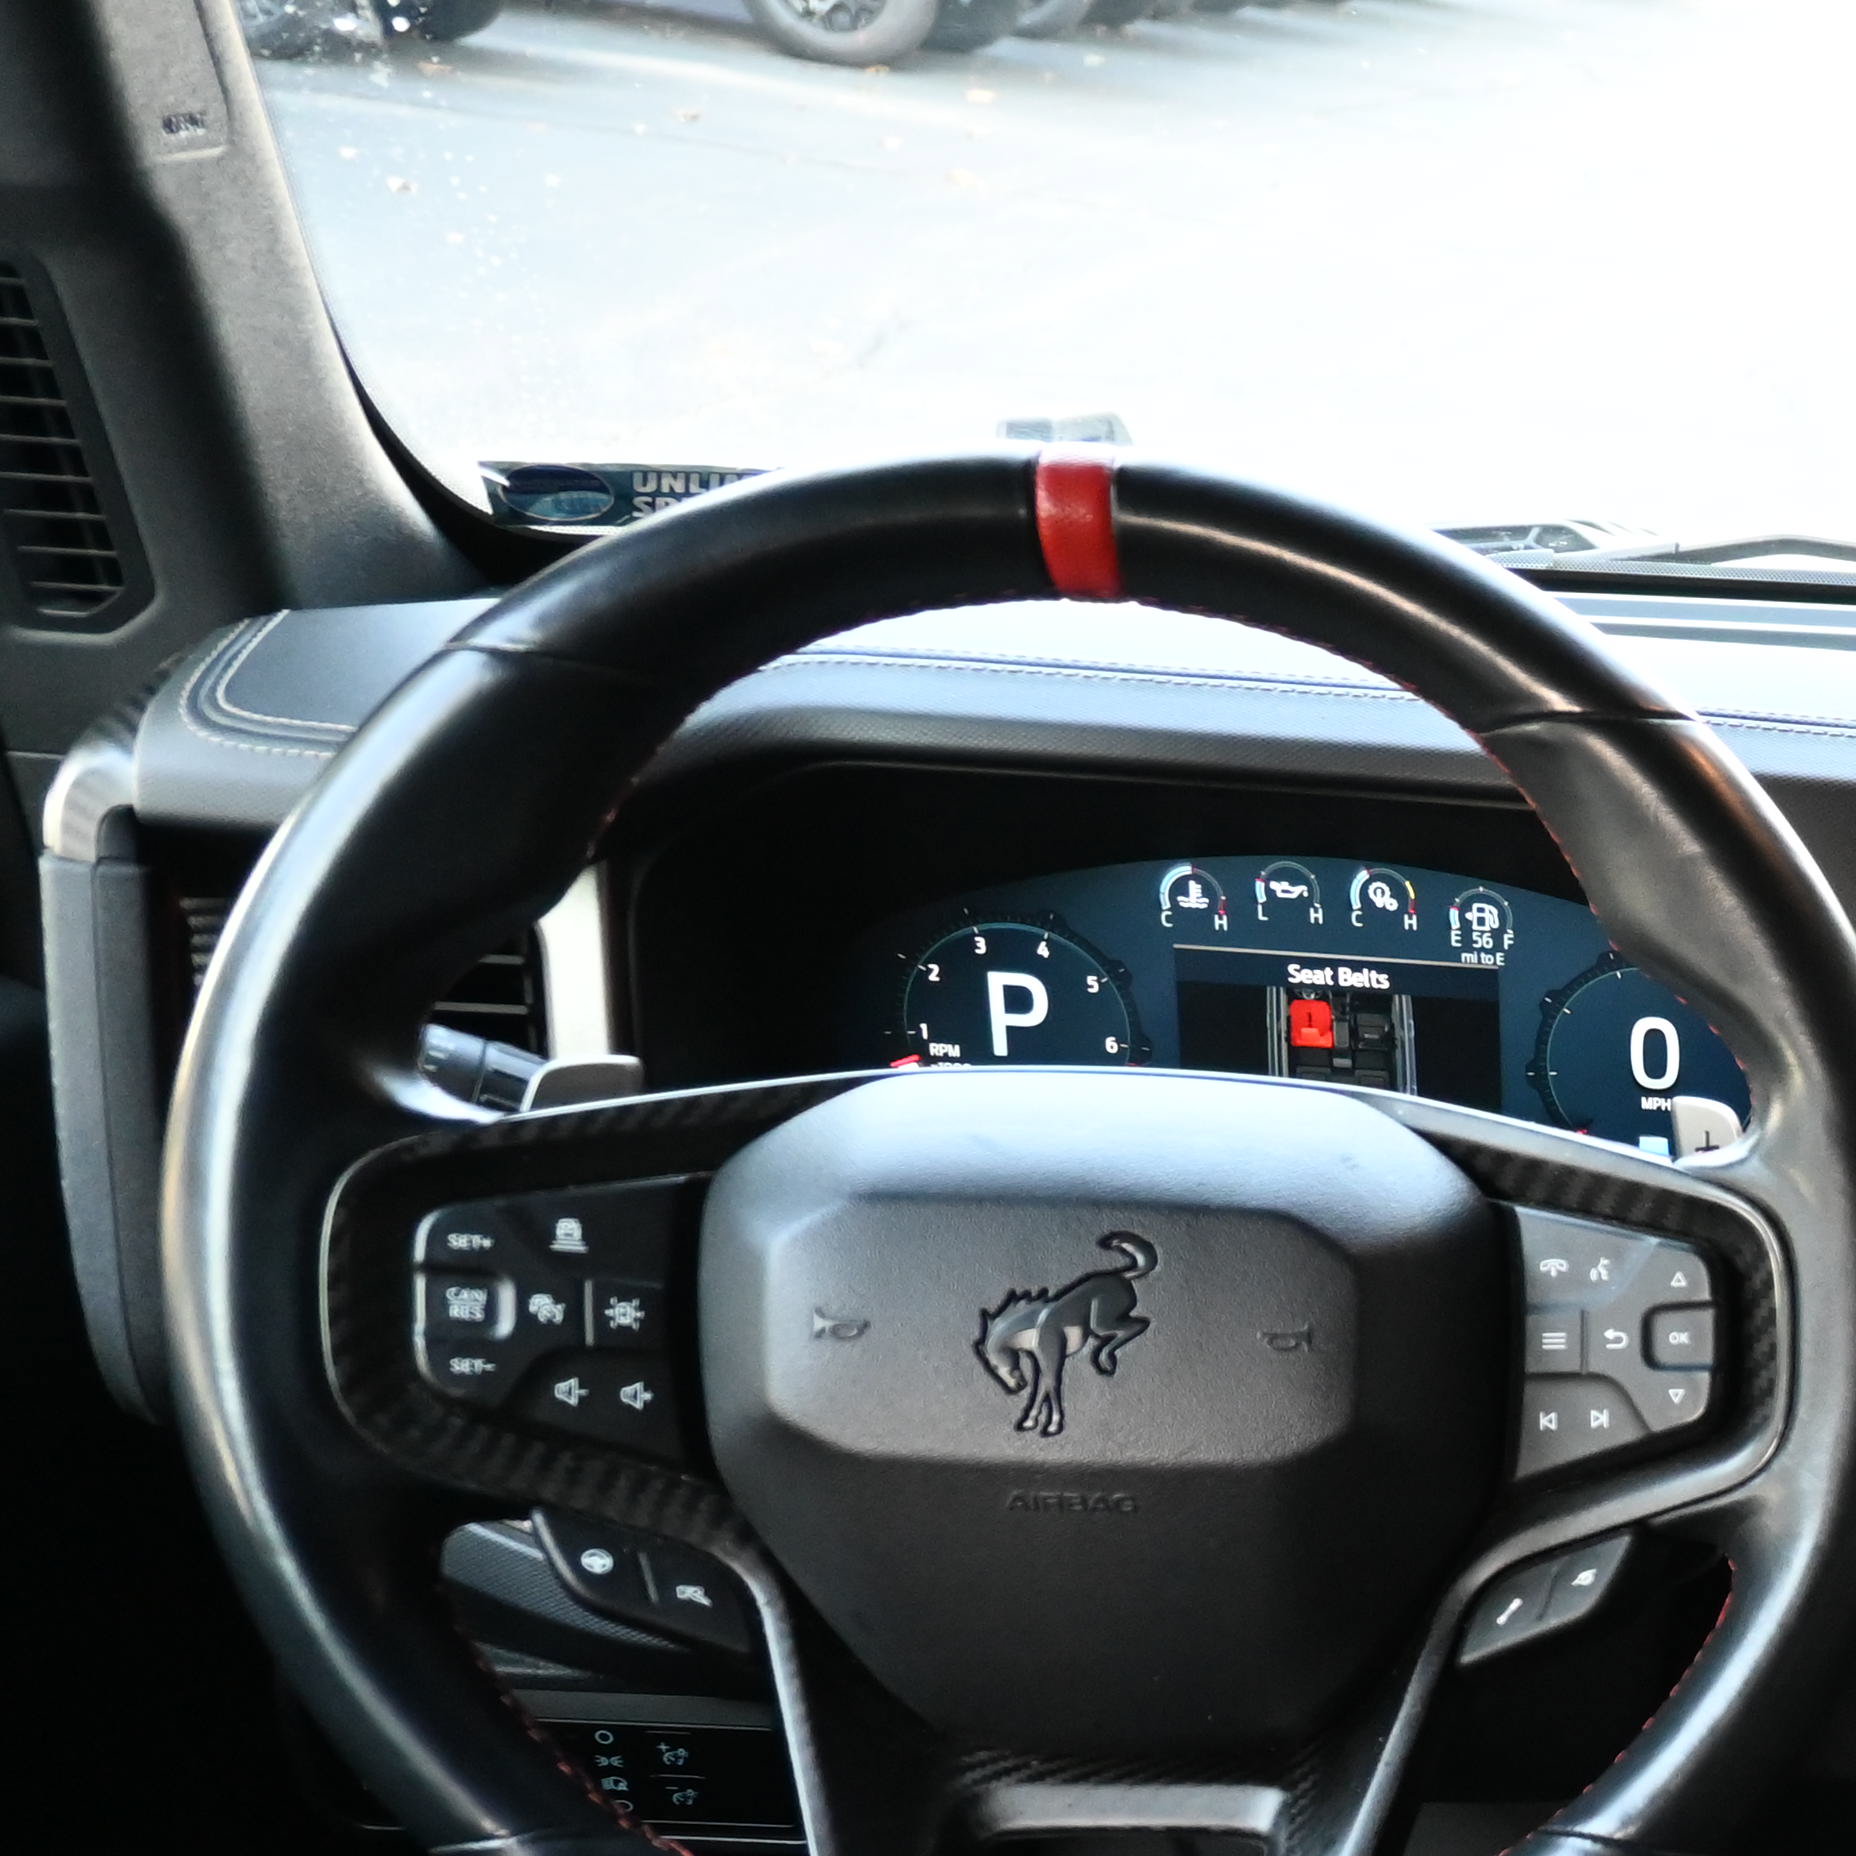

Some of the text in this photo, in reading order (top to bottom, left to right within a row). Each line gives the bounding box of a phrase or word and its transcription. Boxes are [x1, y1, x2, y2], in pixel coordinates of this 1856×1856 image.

[1161, 910, 1173, 928] C
[1258, 904, 1269, 921] L
[1310, 908, 1324, 925] H
[1351, 911, 1363, 928] C
[1215, 915, 1228, 931] H
[1404, 914, 1418, 931] H
[974, 936, 987, 955] 3
[1451, 931, 1515, 950] E 56 F
[1037, 941, 1049, 958] 4
[1461, 952, 1505, 966] mi to E
[927, 964, 941, 982] 2
[1288, 964, 1390, 989] Seat Belts
[1086, 976, 1099, 993] 5
[987, 971, 1048, 1057] P
[920, 1023, 928, 1040] 1
[929, 1042, 961, 1058] RPM
[1105, 1037, 1119, 1053] 6
[1630, 1016, 1681, 1091] 0
[1641, 1097, 1671, 1111] MPH
[1669, 1331, 1689, 1345] OK
[1005, 1489, 1138, 1513] AIRBAG
